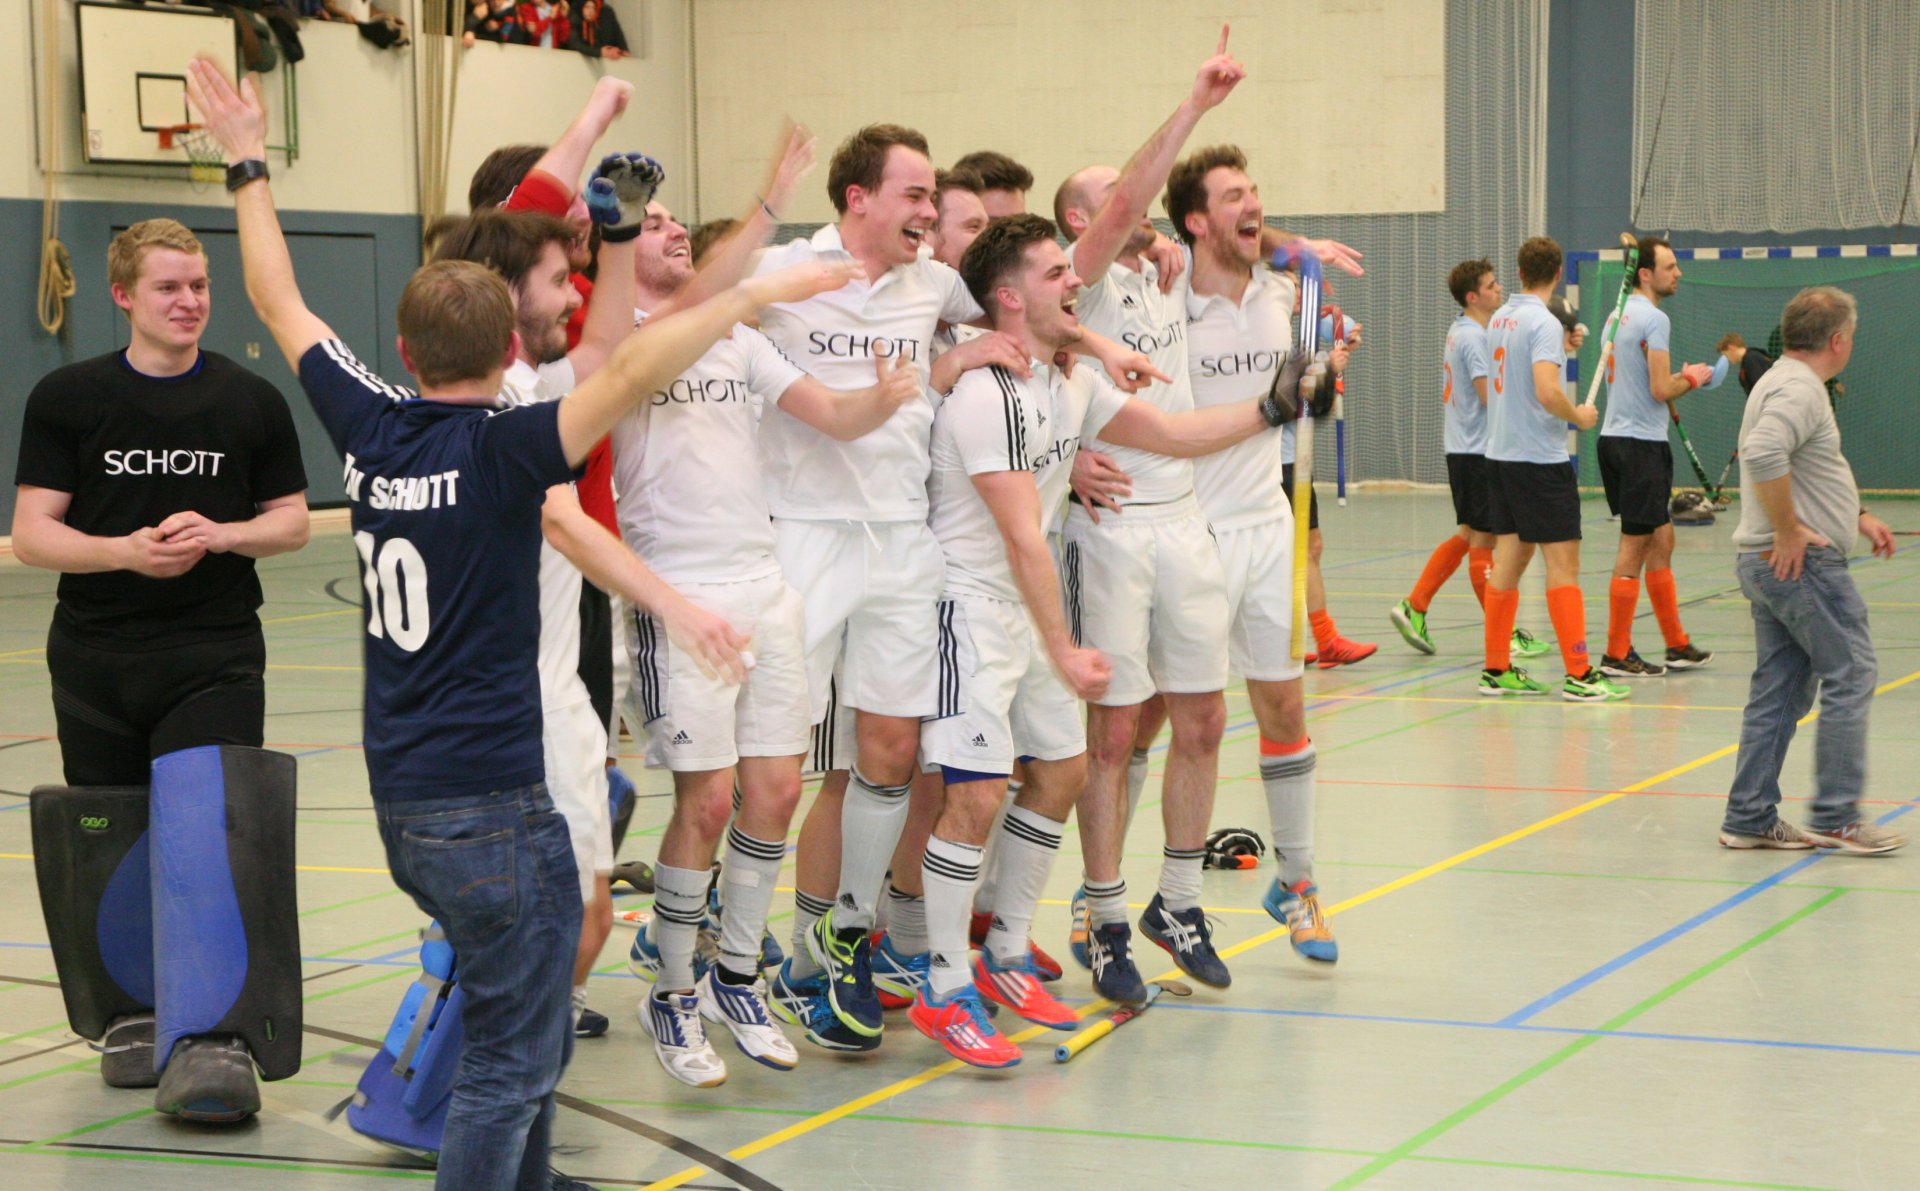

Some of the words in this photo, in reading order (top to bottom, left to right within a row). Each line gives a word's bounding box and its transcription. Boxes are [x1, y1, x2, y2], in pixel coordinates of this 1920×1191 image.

[808, 331, 919, 362] SCHOTT
[652, 379, 746, 406] SCHOTT
[104, 449, 225, 477] SCHOTT
[369, 470, 459, 510] SCHOTT
[353, 530, 430, 652] 10
